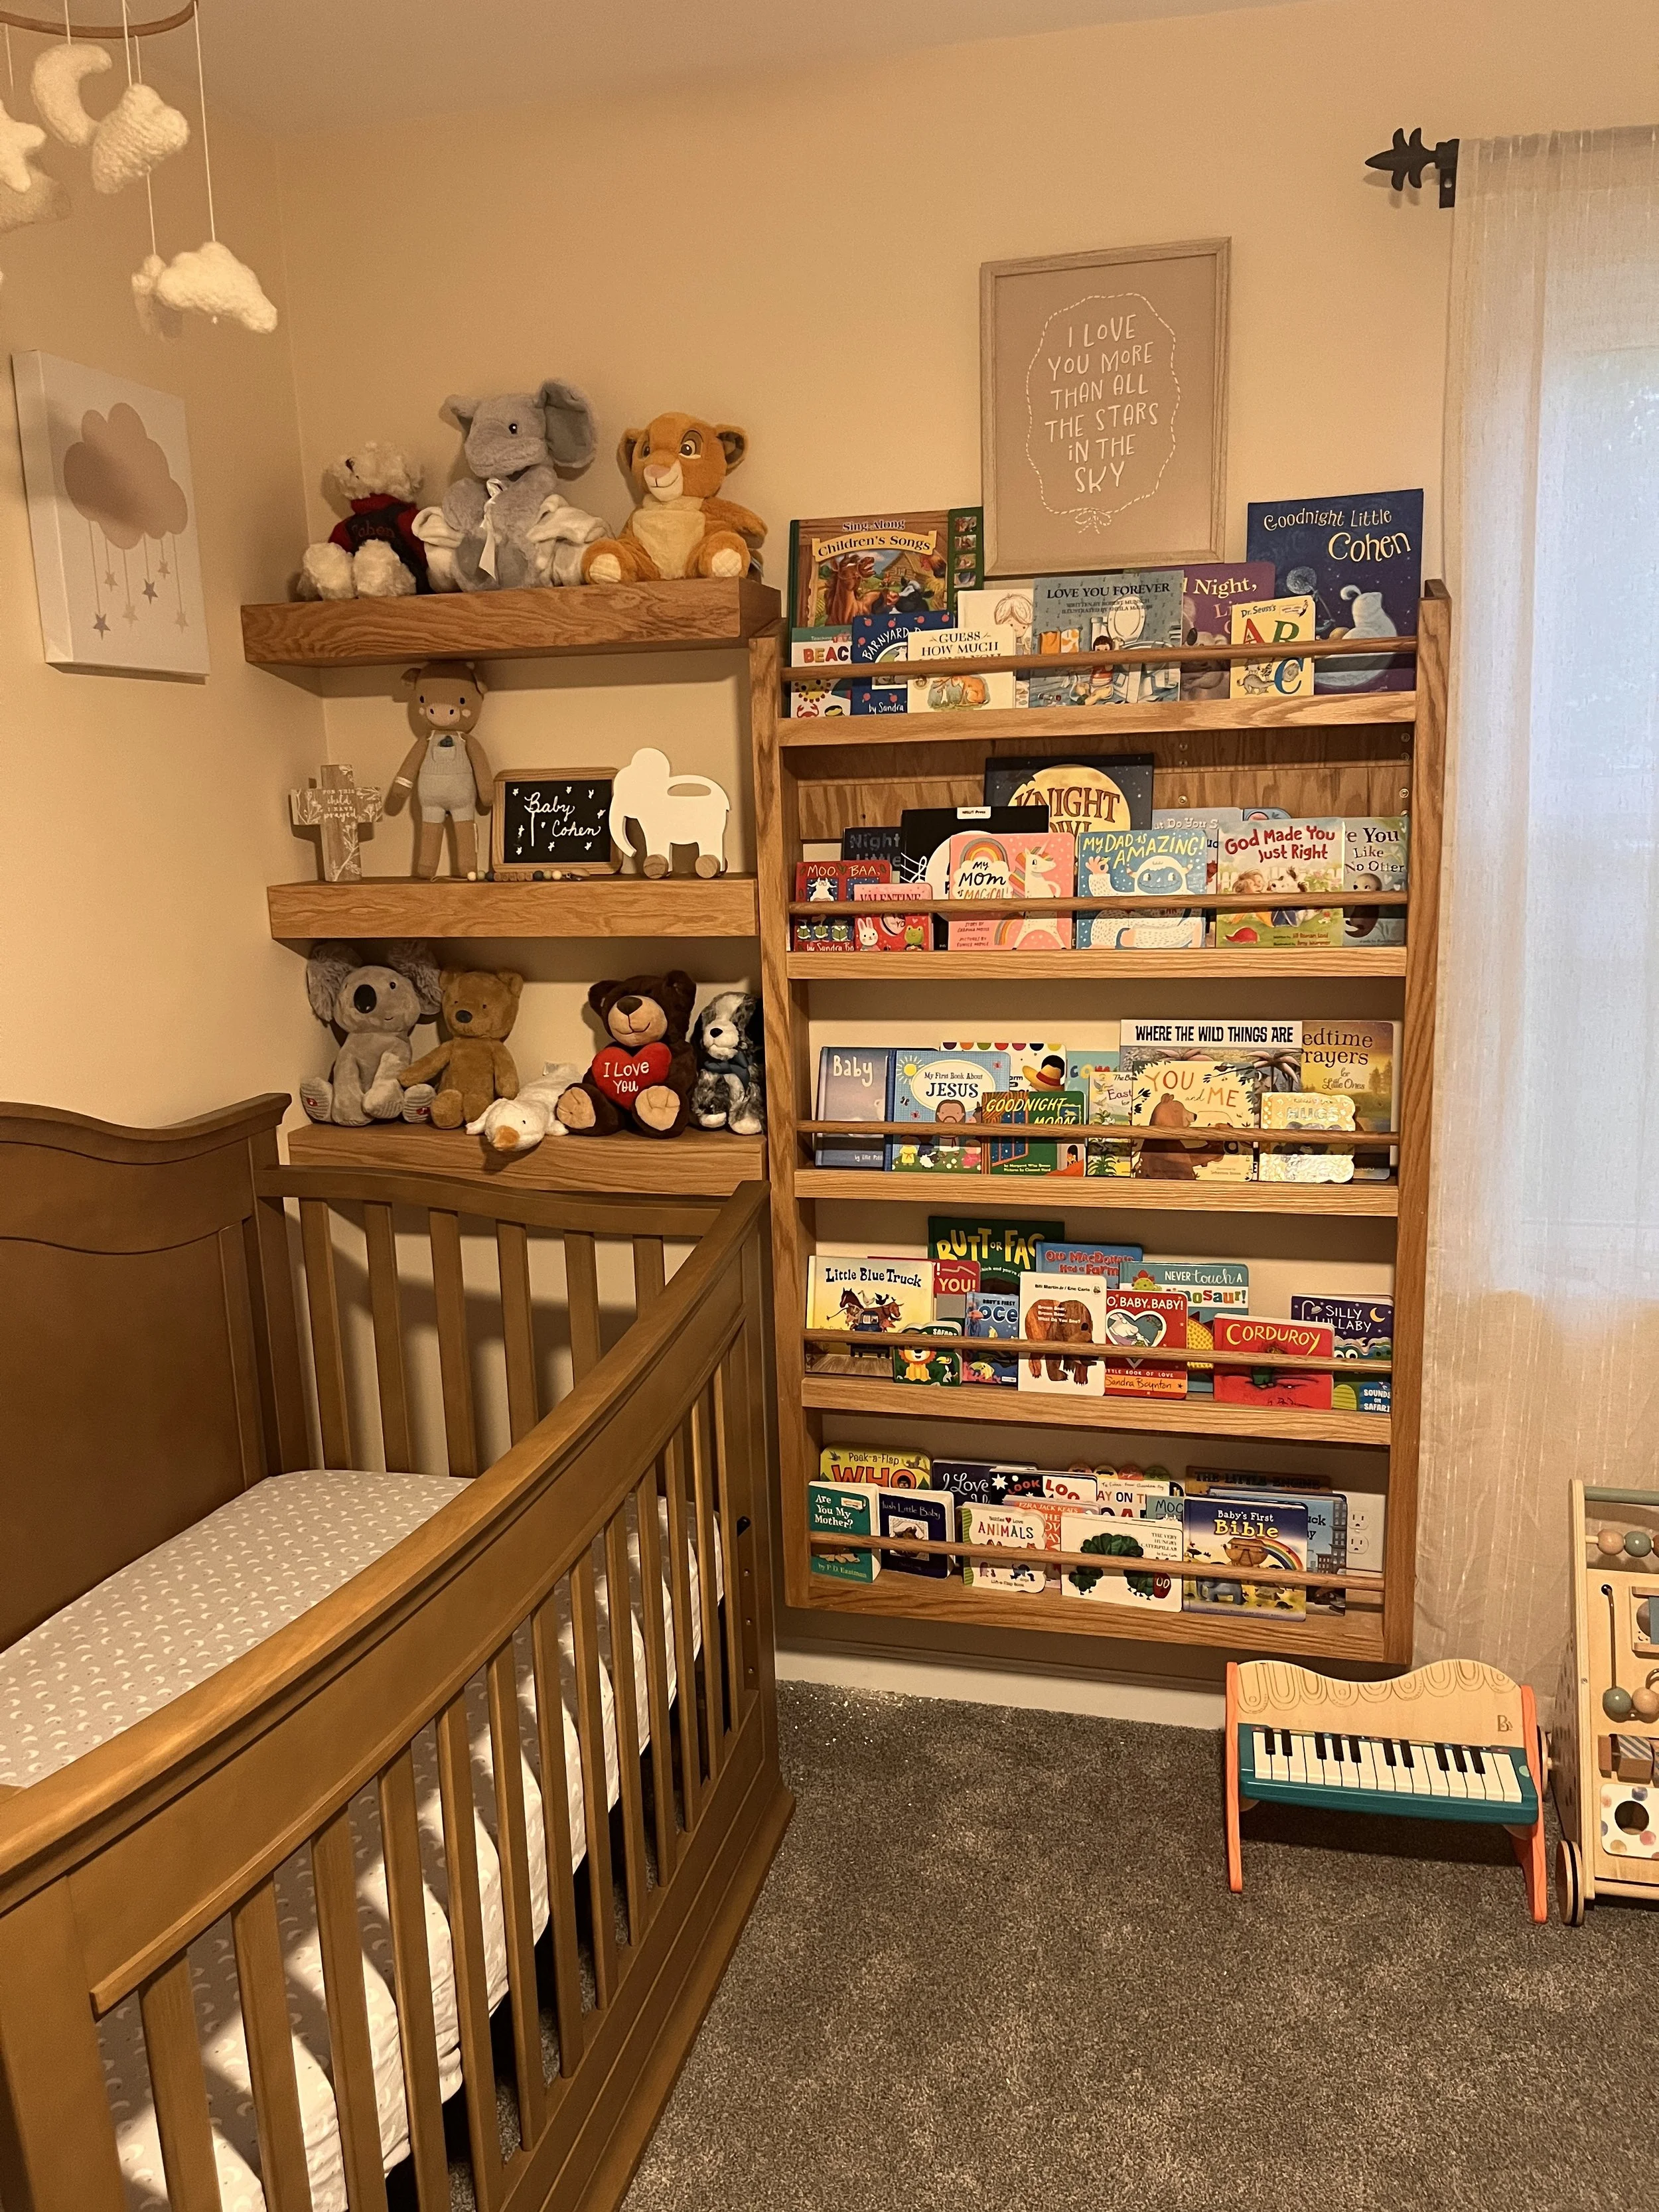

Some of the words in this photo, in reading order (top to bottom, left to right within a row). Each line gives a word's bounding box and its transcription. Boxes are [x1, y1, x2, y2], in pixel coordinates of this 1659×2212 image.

[1068, 326, 1072, 348] I
[1084, 313, 1137, 347] LOVE
[1047, 355, 1089, 381] YOU
[1102, 342, 1153, 374] MORE
[1050, 380, 1103, 410] THAN
[1113, 373, 1148, 396] ALL
[1045, 413, 1084, 443] THE
[1096, 402, 1159, 431] STARS
[1096, 433, 1136, 459] THE
[1075, 461, 1125, 494] SKY
[842, 519, 906, 532] Sing-Along
[1263, 508, 1345, 531] Goodnight
[1351, 508, 1392, 528] Little
[818, 536, 886, 557] Children's
[890, 535, 931, 552] Songs
[1329, 532, 1411, 562] Cohen
[1046, 587, 1079, 599] LOVE
[1082, 586, 1110, 597] YOU
[1113, 583, 1171, 596] FOREVER
[1194, 577, 1258, 599] Night,
[1241, 606, 1253, 618] Dr.
[1253, 603, 1277, 616] Seuss's
[862, 627, 909, 661] BARNYARD
[939, 631, 981, 643] GUESS
[803, 645, 853, 664] BEAC
[922, 644, 954, 656] HOW
[958, 641, 999, 654] MUCH
[869, 704, 878, 713] by
[879, 702, 904, 713] Sandra
[524, 792, 575, 825] Baby
[1014, 786, 1120, 823] KNIGHT
[551, 820, 601, 838] Cohen
[1167, 818, 1183, 829] Do
[1185, 816, 1207, 830] You
[849, 832, 901, 850] Night
[1105, 834, 1133, 853] DAD
[1225, 828, 1260, 855] God
[1263, 826, 1303, 846] Made
[1306, 825, 1336, 842] You
[1362, 827, 1400, 844] You
[1113, 834, 1204, 869] AMAZING!
[1258, 846, 1288, 863] Just
[1291, 844, 1329, 861] Right
[1353, 846, 1384, 859] Like
[1345, 862, 1364, 873] No
[1368, 860, 1405, 873] Otter
[817, 942, 843, 952] Sandra
[1135, 1025, 1173, 1042] WHERE
[1175, 1025, 1194, 1042] THE
[1198, 1026, 1225, 1043] WILD
[1228, 1026, 1267, 1043] THINGS
[1271, 1027, 1294, 1043] ARE
[1302, 1027, 1374, 1049] edtime
[603, 1062, 611, 1078] I
[614, 1061, 650, 1077] Love
[833, 1055, 873, 1087] Baby
[926, 1082, 979, 1098] JESUS
[1145, 1070, 1194, 1092] YOU
[1344, 1078, 1366, 1090] Ones
[985, 1097, 1068, 1114] GOODNIGHT
[1185, 1088, 1206, 1102] and
[1207, 1086, 1240, 1108] ME
[1034, 1116, 1076, 1125] MOON
[936, 1228, 993, 1262] BUTT
[989, 1241, 1003, 1252] OR
[1004, 1230, 1045, 1270] FAC
[825, 1267, 857, 1283] Little
[859, 1267, 885, 1282] Blue
[886, 1268, 922, 1288] Truck
[1165, 1270, 1191, 1282] NEVER
[1191, 1268, 1236, 1284] touch
[1236, 1274, 1243, 1283] A
[938, 1278, 976, 1293] YOU!
[1151, 1299, 1185, 1311] BABY!
[1325, 1305, 1362, 1320] SILLY
[1315, 1315, 1372, 1333] LULLABY
[1226, 1323, 1321, 1356] CORDUROY
[1105, 1376, 1135, 1388] Sandra
[1135, 1377, 1172, 1392] Boynton
[1364, 1388, 1391, 1399] SOUNDS
[1364, 1402, 1391, 1413] SAFARI
[848, 1452, 900, 1467] Peek-a-Flap
[831, 1464, 918, 1490] WHO
[950, 1473, 989, 1495] Love
[1007, 1479, 1041, 1495] LOOK
[816, 1494, 831, 1505] Are
[1116, 1491, 1133, 1503] ON
[816, 1504, 833, 1515] You
[835, 1505, 852, 1519] My
[898, 1503, 917, 1514] Little
[919, 1507, 940, 1520] Baby
[1057, 1505, 1079, 1514] KEATS
[1217, 1510, 1248, 1520] Baby's
[1250, 1512, 1274, 1522] First
[814, 1514, 854, 1530] Mother?
[978, 1521, 1035, 1540] ANIMALS
[1214, 1518, 1279, 1538] Bible
